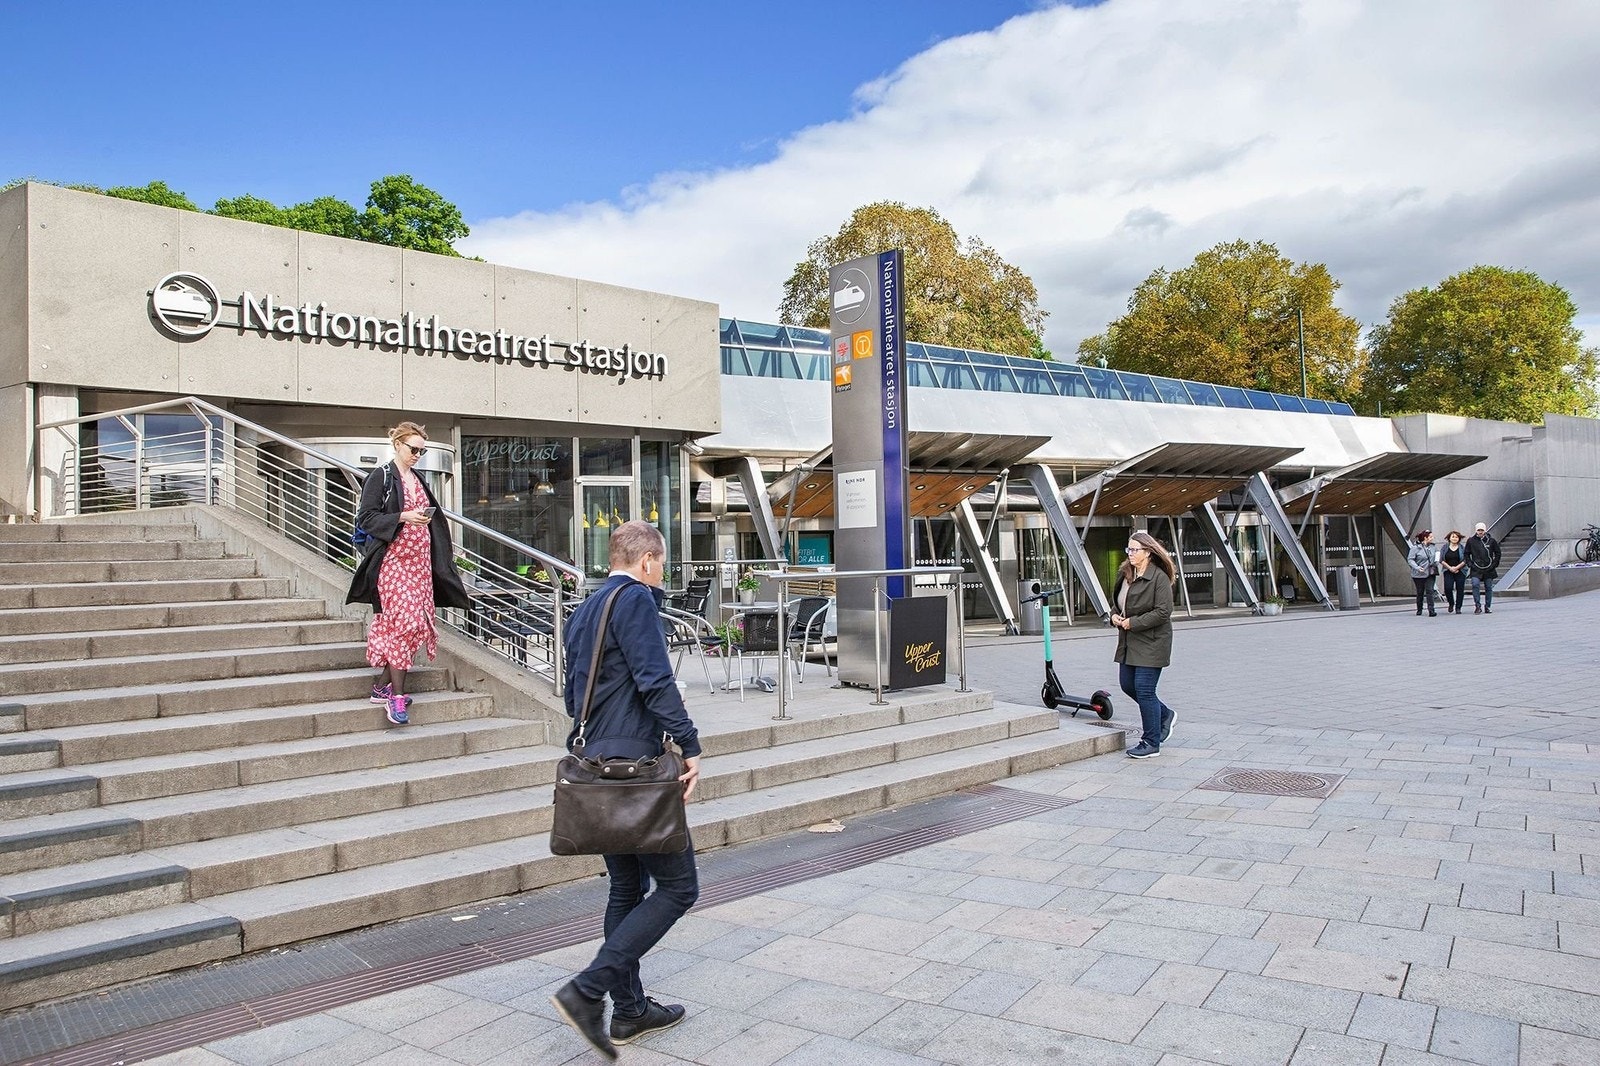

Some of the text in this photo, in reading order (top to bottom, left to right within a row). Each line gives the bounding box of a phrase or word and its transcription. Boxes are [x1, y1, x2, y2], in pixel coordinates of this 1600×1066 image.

[242, 291, 669, 379] Nationaltheatret stasjon
[884, 260, 897, 429] Nationaltheatret stasjon
[464, 441, 561, 466] Upper Crust
[808, 555, 825, 563] ALLE
[905, 642, 934, 663] Upper
[915, 650, 941, 672] Crust
